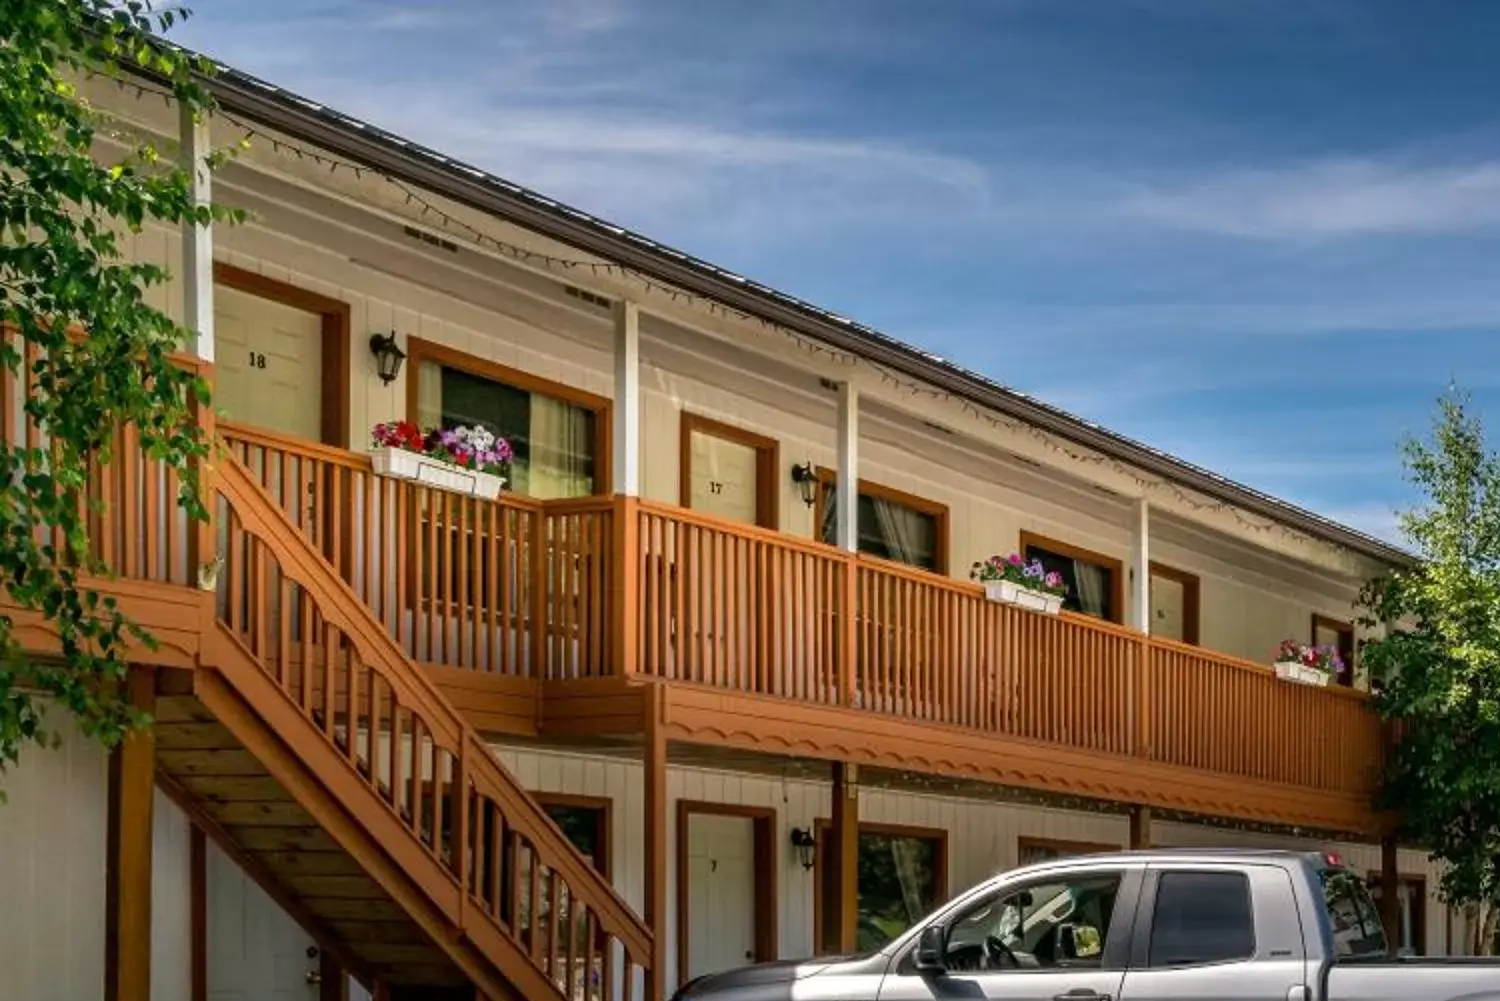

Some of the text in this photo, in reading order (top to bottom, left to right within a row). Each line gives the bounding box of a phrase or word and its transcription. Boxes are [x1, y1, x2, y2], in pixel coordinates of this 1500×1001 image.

[249, 351, 266, 369] 18
[709, 481, 723, 495] 17
[710, 859, 718, 873] 7
